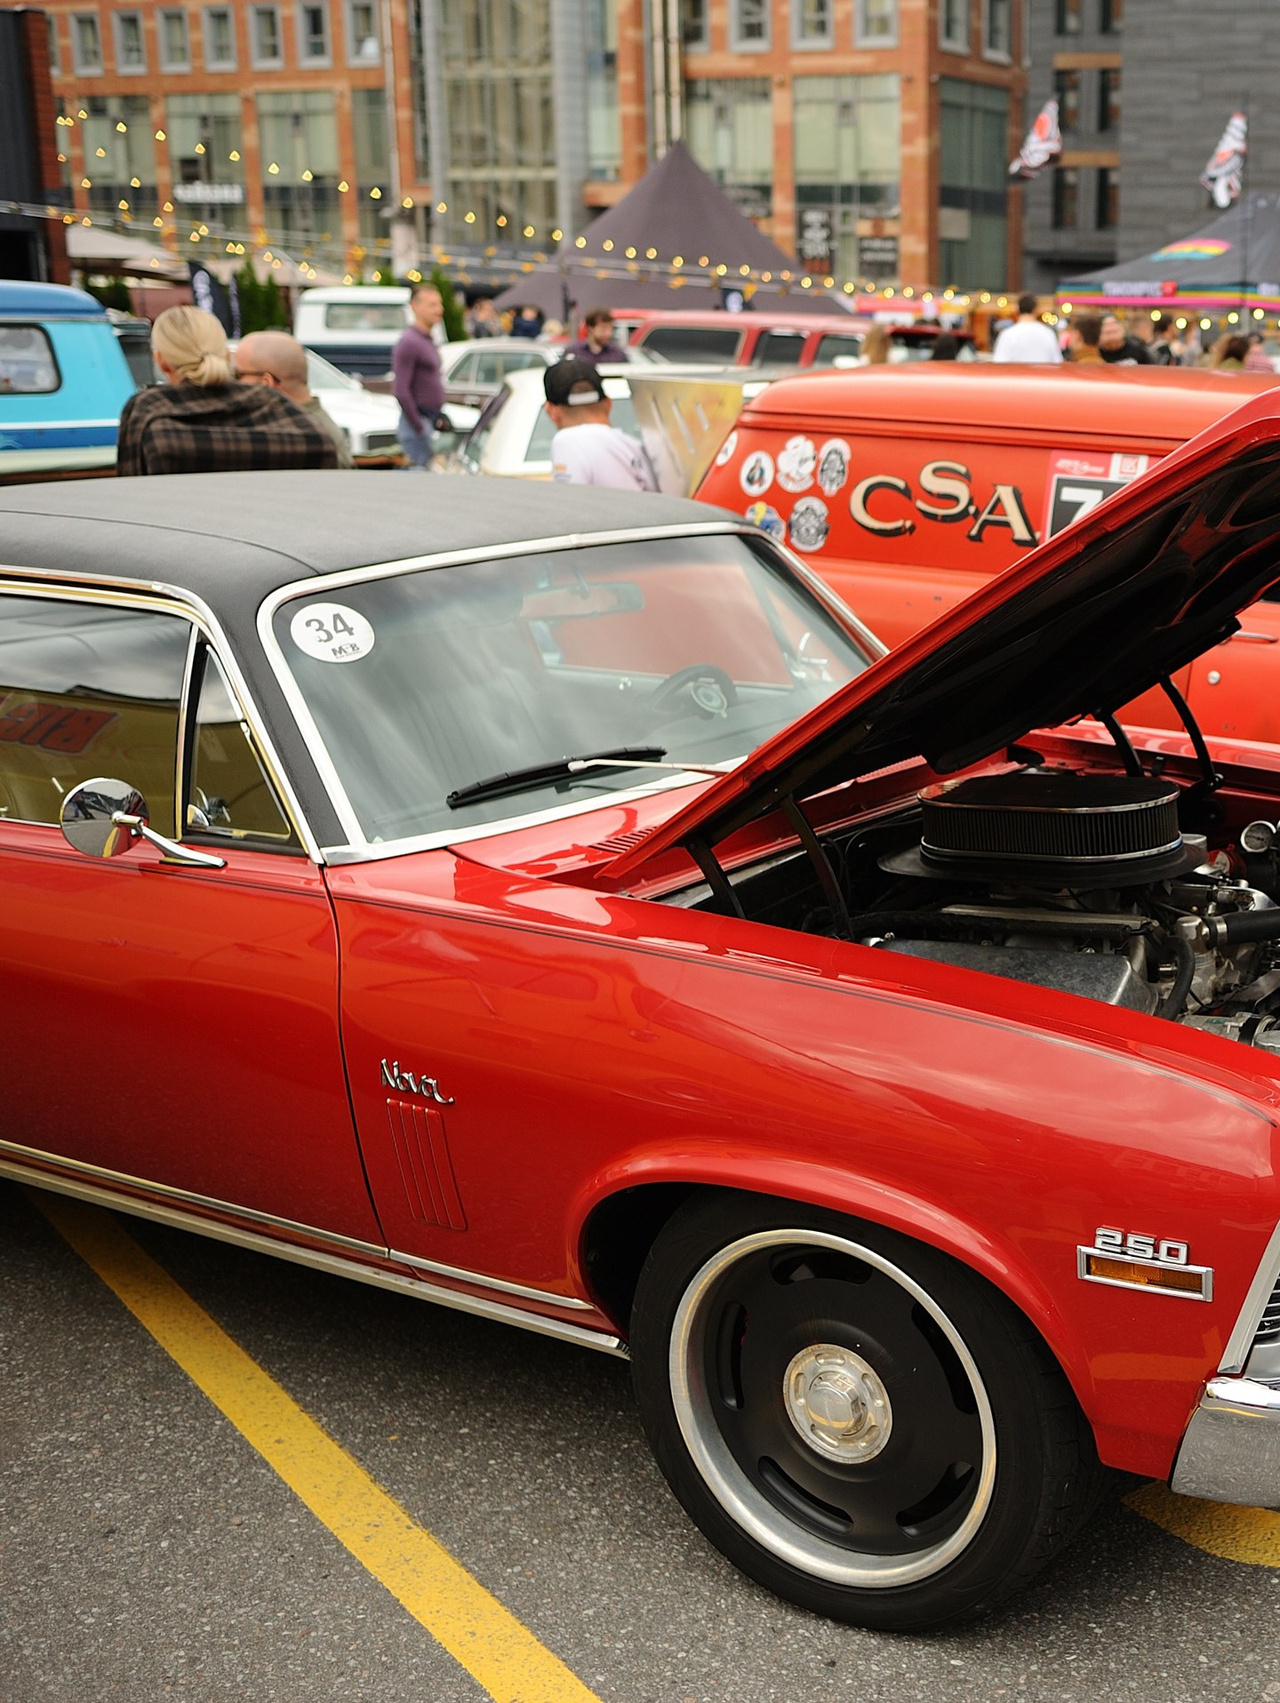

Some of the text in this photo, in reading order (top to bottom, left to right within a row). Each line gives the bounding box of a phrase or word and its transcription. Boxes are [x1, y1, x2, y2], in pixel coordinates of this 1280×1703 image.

[305, 612, 354, 643] 34
[381, 1058, 454, 1104] Nova
[1094, 1226, 1188, 1265] 250
